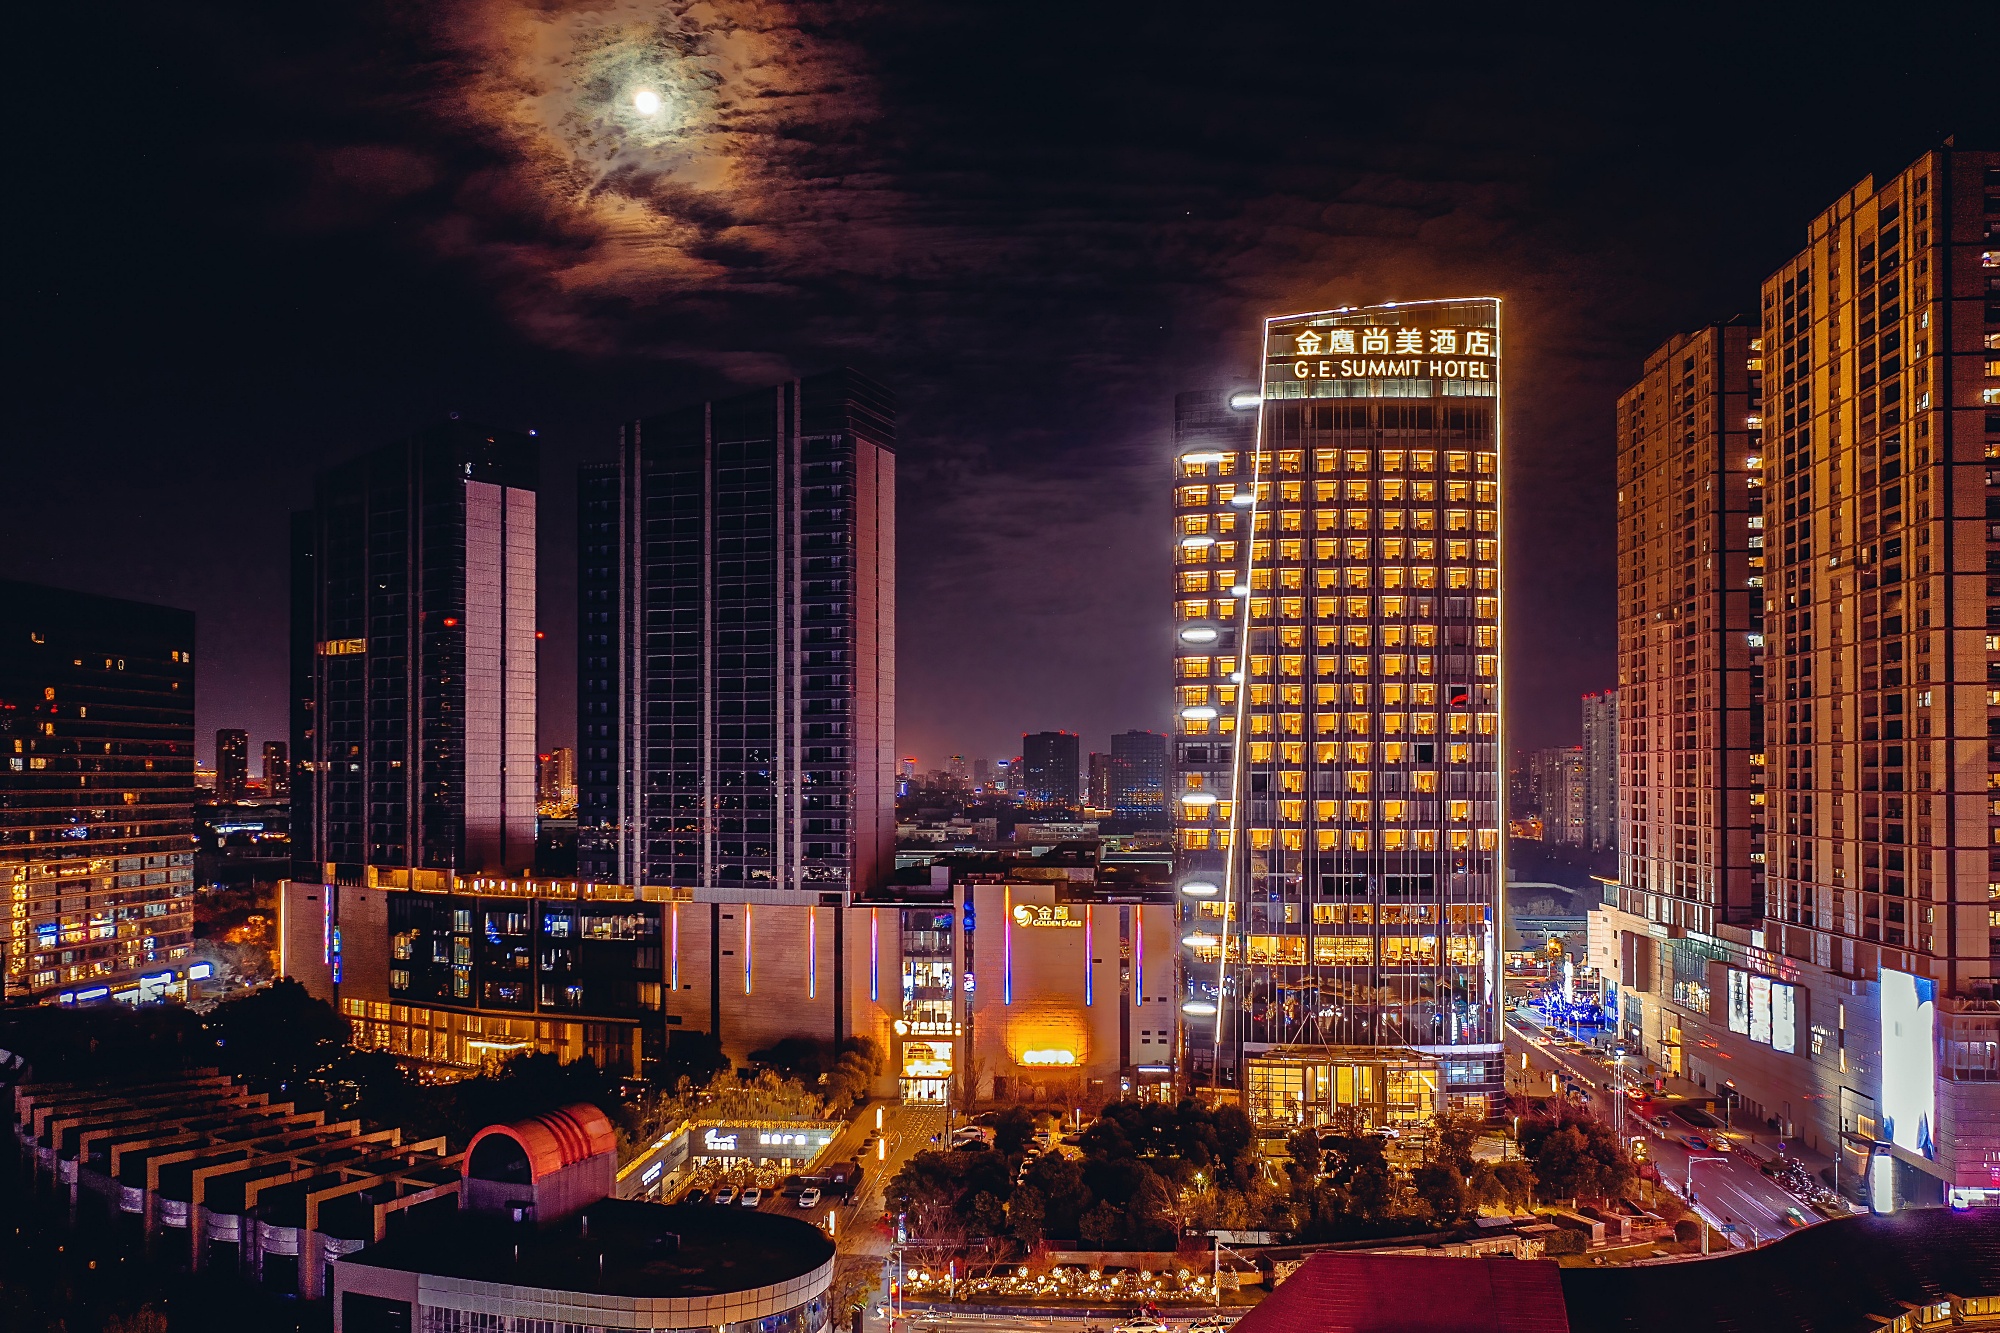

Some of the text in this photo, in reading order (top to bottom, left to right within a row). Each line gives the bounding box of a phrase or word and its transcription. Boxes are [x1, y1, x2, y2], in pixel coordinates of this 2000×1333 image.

[1294, 359, 1489, 378] G.E. SUMMIT HOTEL
